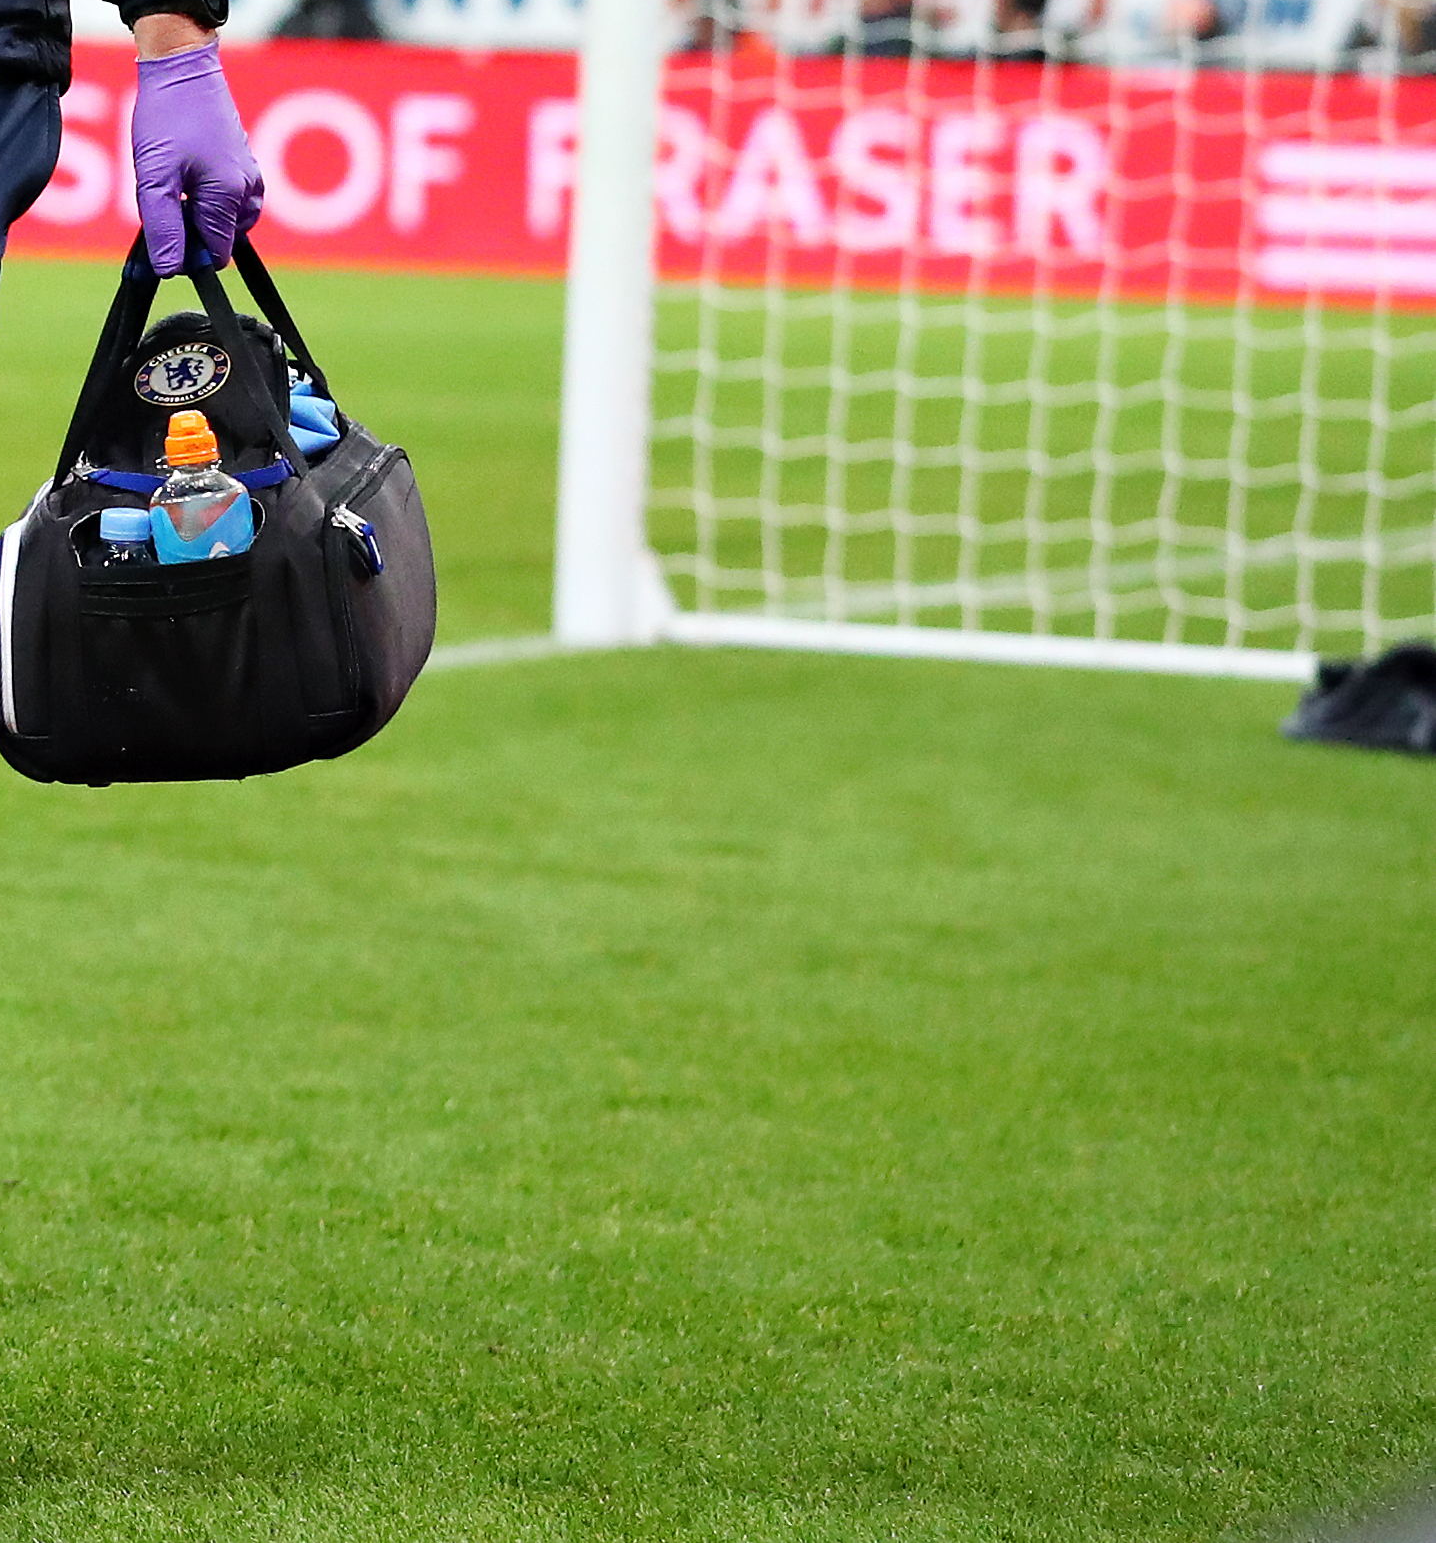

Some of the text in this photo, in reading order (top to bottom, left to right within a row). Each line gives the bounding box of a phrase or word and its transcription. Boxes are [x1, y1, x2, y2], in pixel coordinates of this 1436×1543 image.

[246, 87, 478, 237] OF
[528, 99, 1112, 255] FRASER
[148, 344, 209, 368] CHELSEA
[152, 381, 217, 403] FOOTBALL CLUB
